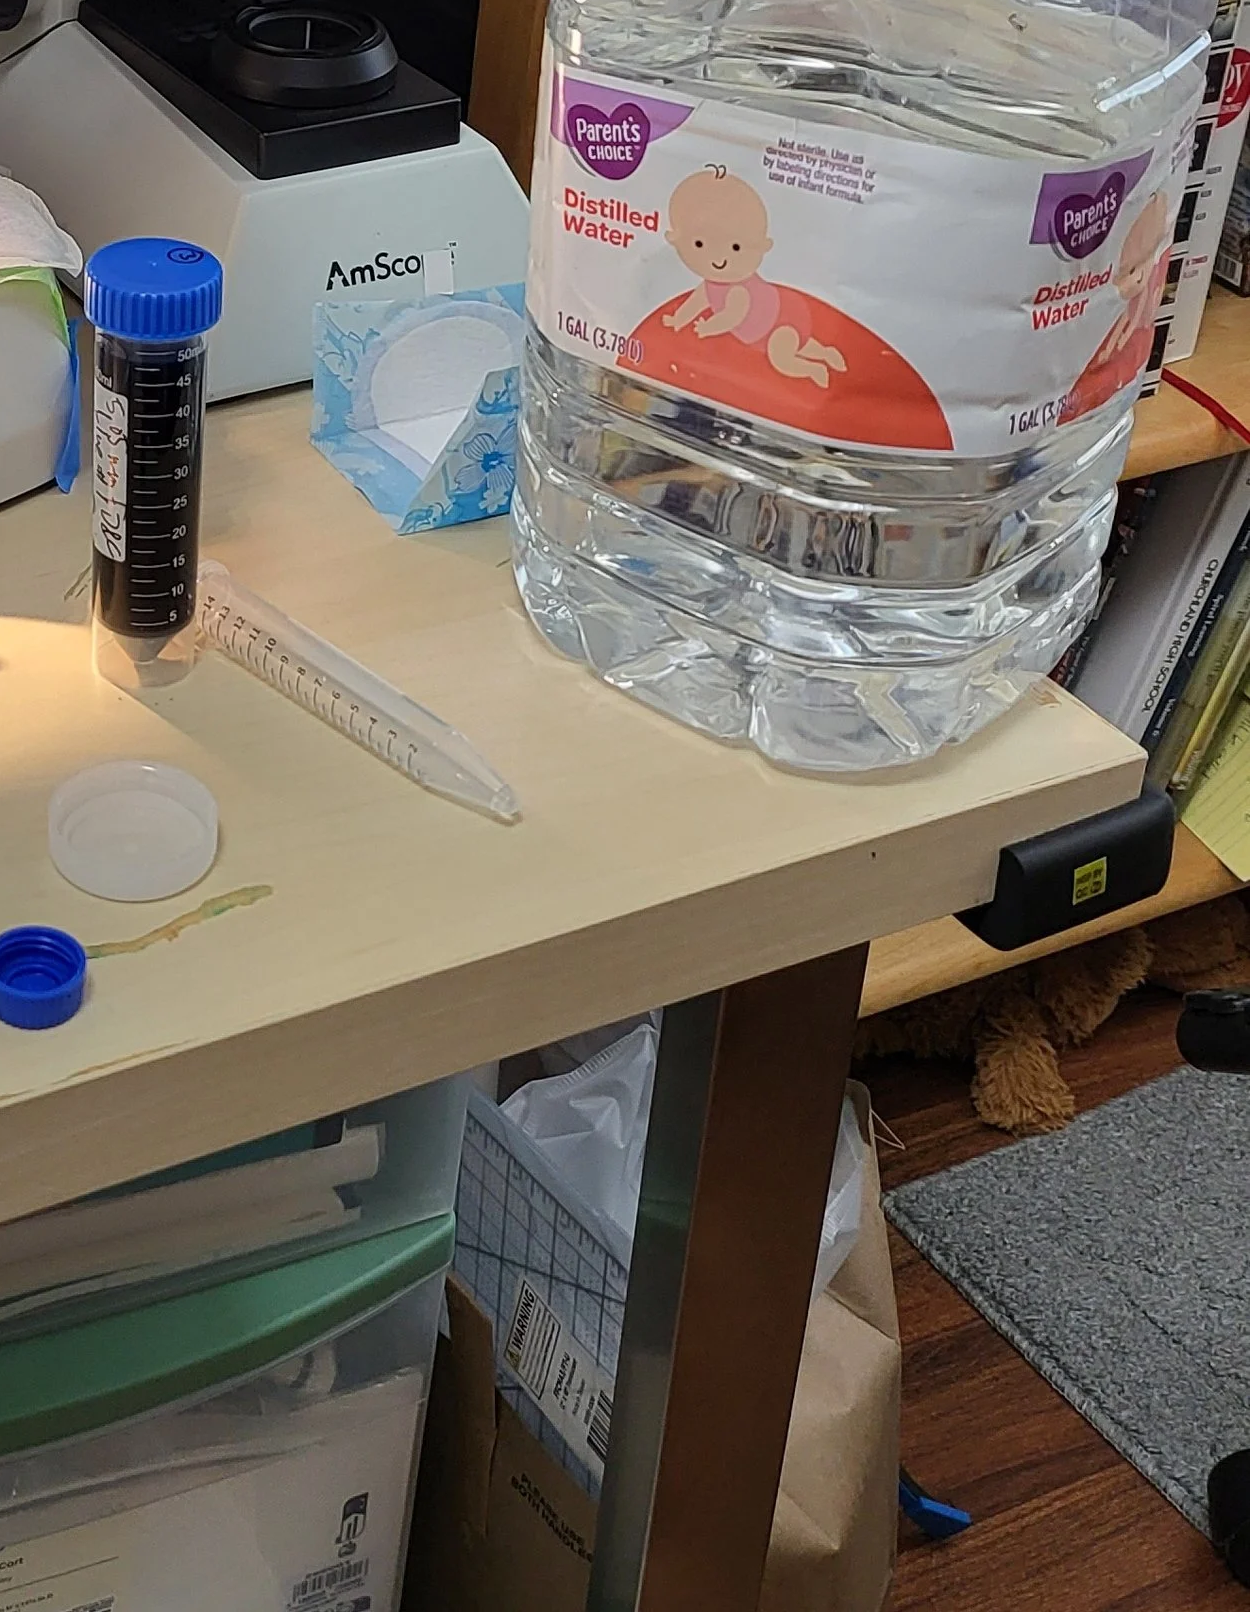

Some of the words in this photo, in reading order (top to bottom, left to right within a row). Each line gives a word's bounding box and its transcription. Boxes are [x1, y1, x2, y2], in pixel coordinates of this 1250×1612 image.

[576, 116, 641, 142] Parent's
[588, 144, 634, 161] CHOICE
[778, 138, 795, 149] Not
[831, 148, 849, 161] Use
[763, 156, 775, 170] by
[814, 169, 859, 189] directions
[862, 179, 875, 192] for
[564, 187, 659, 232] Distilled
[1064, 188, 1117, 235] Parent's
[564, 210, 634, 248] Water
[1070, 217, 1109, 248] CHOICE
[326, 250, 454, 291] AmSco
[1034, 262, 1113, 305] Distilled
[1032, 298, 1089, 331] Water
[558, 311, 563, 330] 1
[566, 316, 589, 342] GAL
[593, 327, 626, 355] (3.78
[176, 373, 192, 387] 45
[175, 404, 191, 418] 40
[1010, 413, 1015, 435] 1
[1019, 407, 1039, 433] GAL
[175, 435, 190, 449] 35
[174, 465, 189, 480] 30
[173, 495, 188, 510] 25
[172, 525, 187, 539] 20
[172, 554, 186, 568] 15
[171, 583, 185, 597] 10
[1178, 558, 1219, 633] CHURCHLAND
[203, 595, 216, 610] 14
[218, 605, 230, 620] 13
[169, 610, 178, 622] 5
[233, 615, 246, 630] 12
[249, 627, 261, 641] 11
[264, 637, 277, 653] 10
[1163, 634, 1184, 665] HIGH
[280, 654, 289, 665] 9
[297, 666, 306, 676] 8
[332, 690, 341, 700] 6
[1141, 667, 1171, 713] SCHOOL
[511, 1288, 535, 1351] WARNING
[511, 1474, 540, 1514] BOTH
[521, 1472, 558, 1522] PLEASE
[560, 1519, 586, 1547] USE
